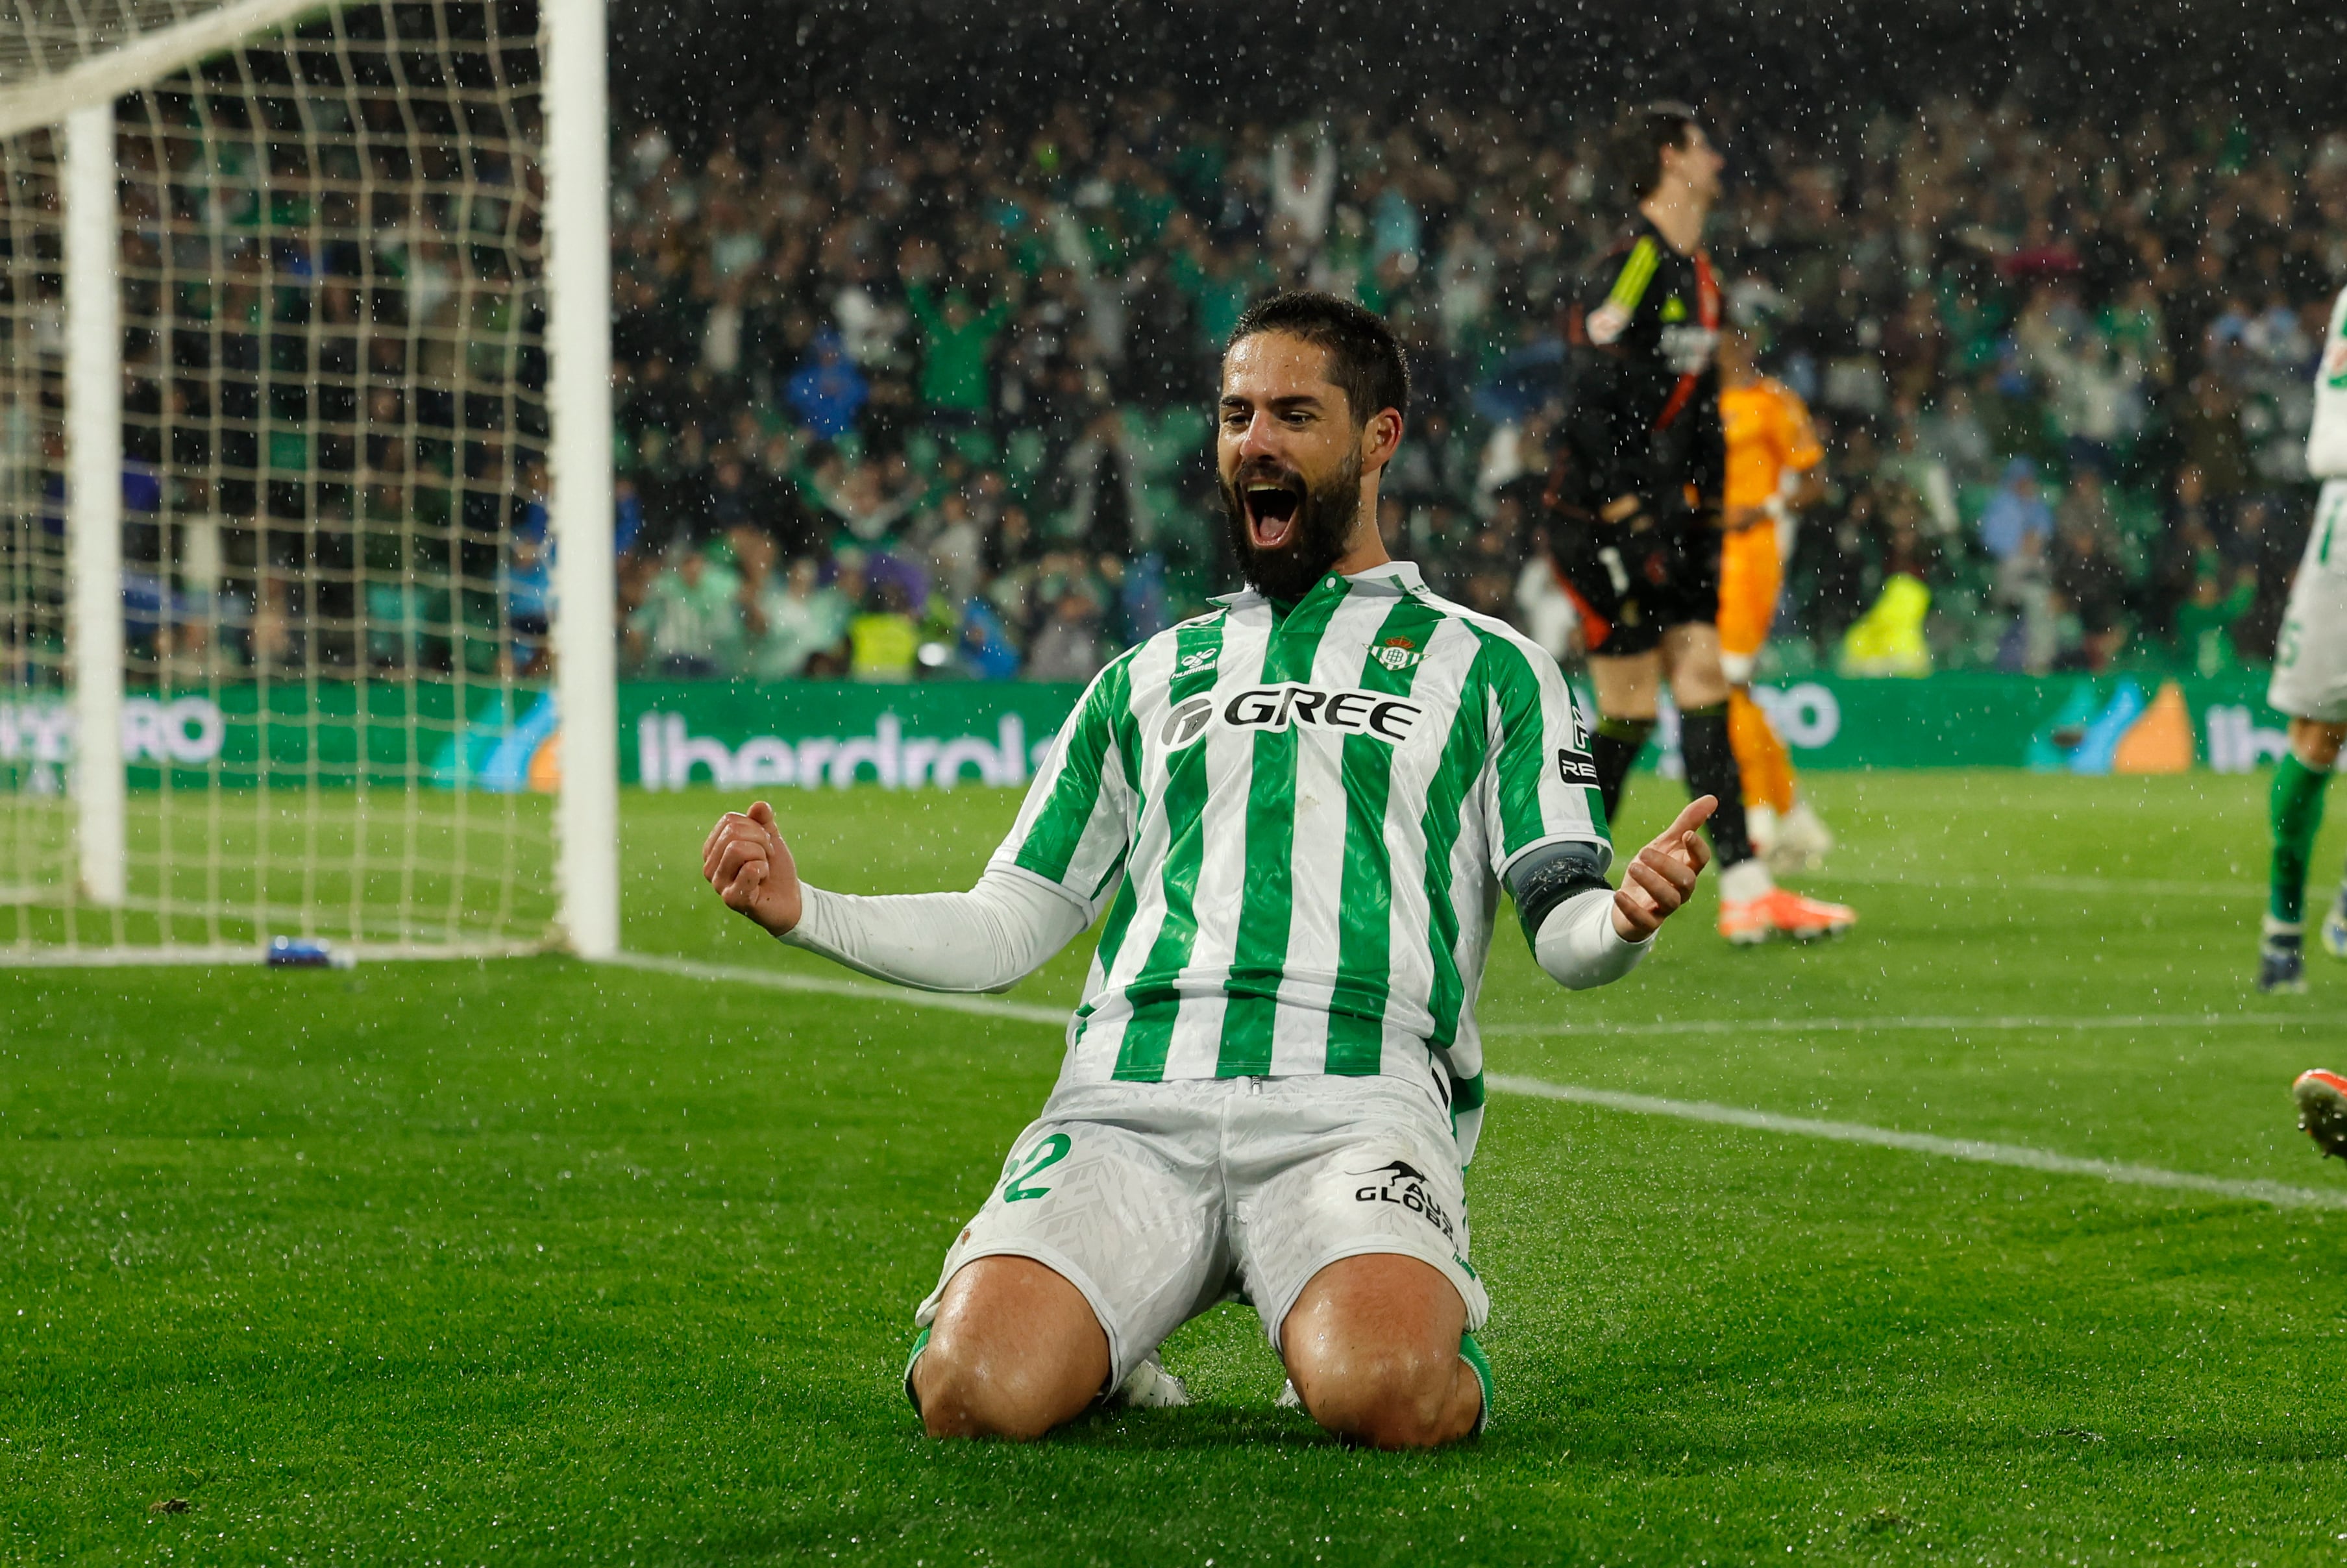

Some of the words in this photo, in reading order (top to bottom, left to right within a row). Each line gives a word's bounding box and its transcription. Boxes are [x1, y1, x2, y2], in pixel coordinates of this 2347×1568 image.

[1171, 659, 1216, 680] hummel
[1224, 687, 1422, 741] GREE
[1562, 759, 1597, 778] RE
[1355, 1186, 1459, 1253] GLOBA
